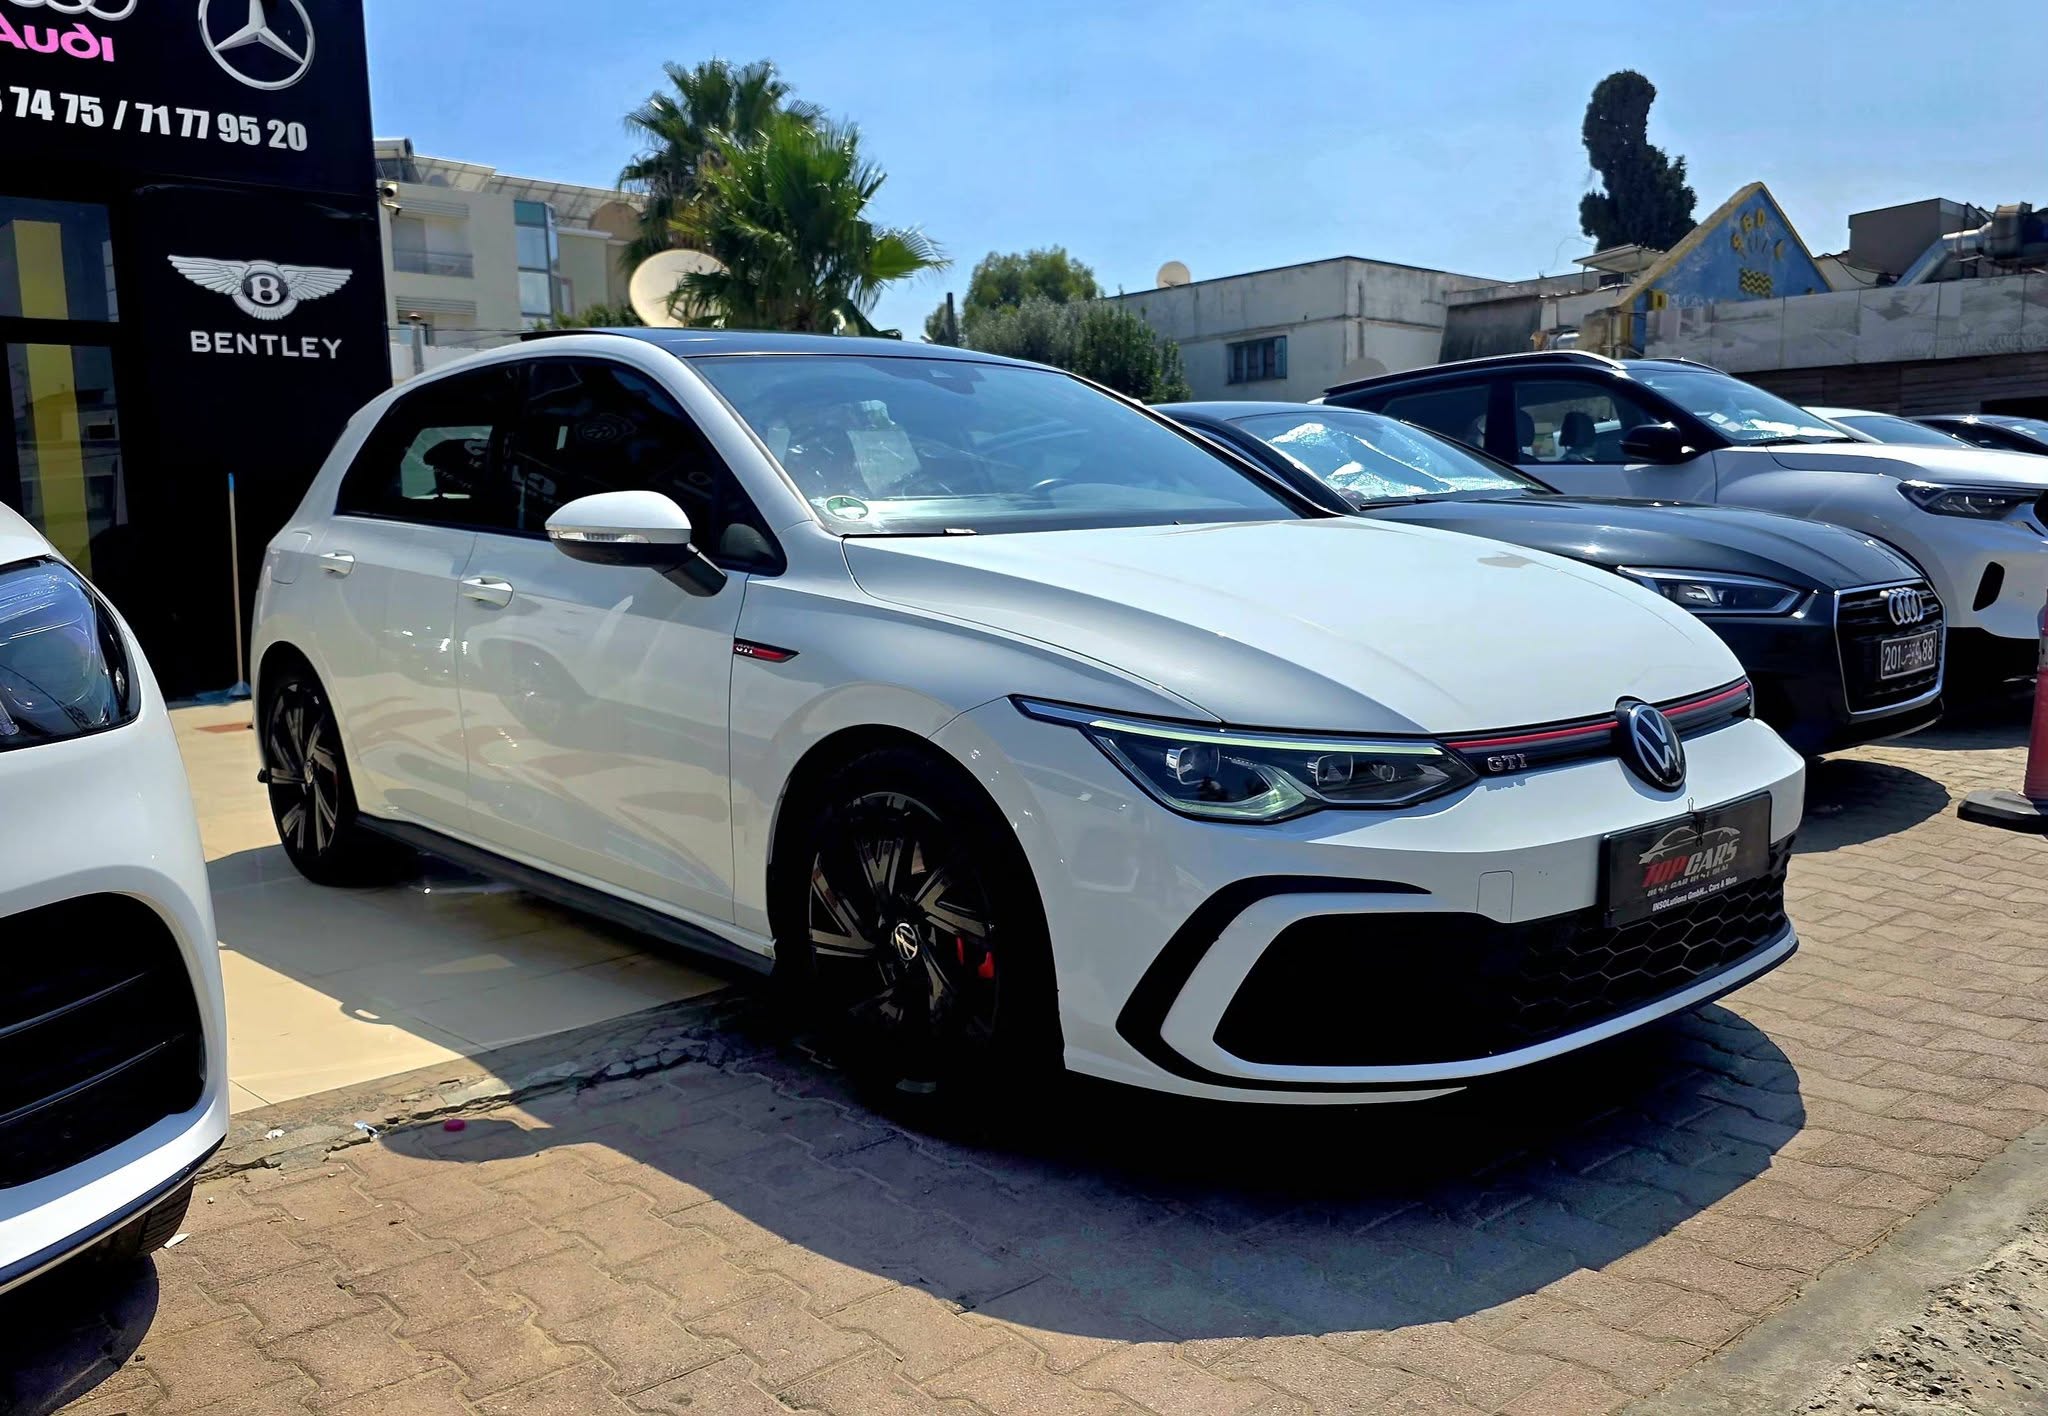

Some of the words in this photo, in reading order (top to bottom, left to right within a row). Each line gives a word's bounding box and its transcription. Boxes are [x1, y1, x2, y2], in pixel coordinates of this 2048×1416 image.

[0, 12, 115, 62] Audi
[9, 85, 55, 121] 74
[59, 92, 105, 128] 75
[134, 102, 171, 136] 71
[175, 107, 210, 140] 77
[217, 112, 261, 146] 95
[266, 119, 308, 152] 20
[190, 330, 342, 359] BENTLEY
[1885, 645, 1901, 671] 201
[1487, 753, 1528, 772] GTI
